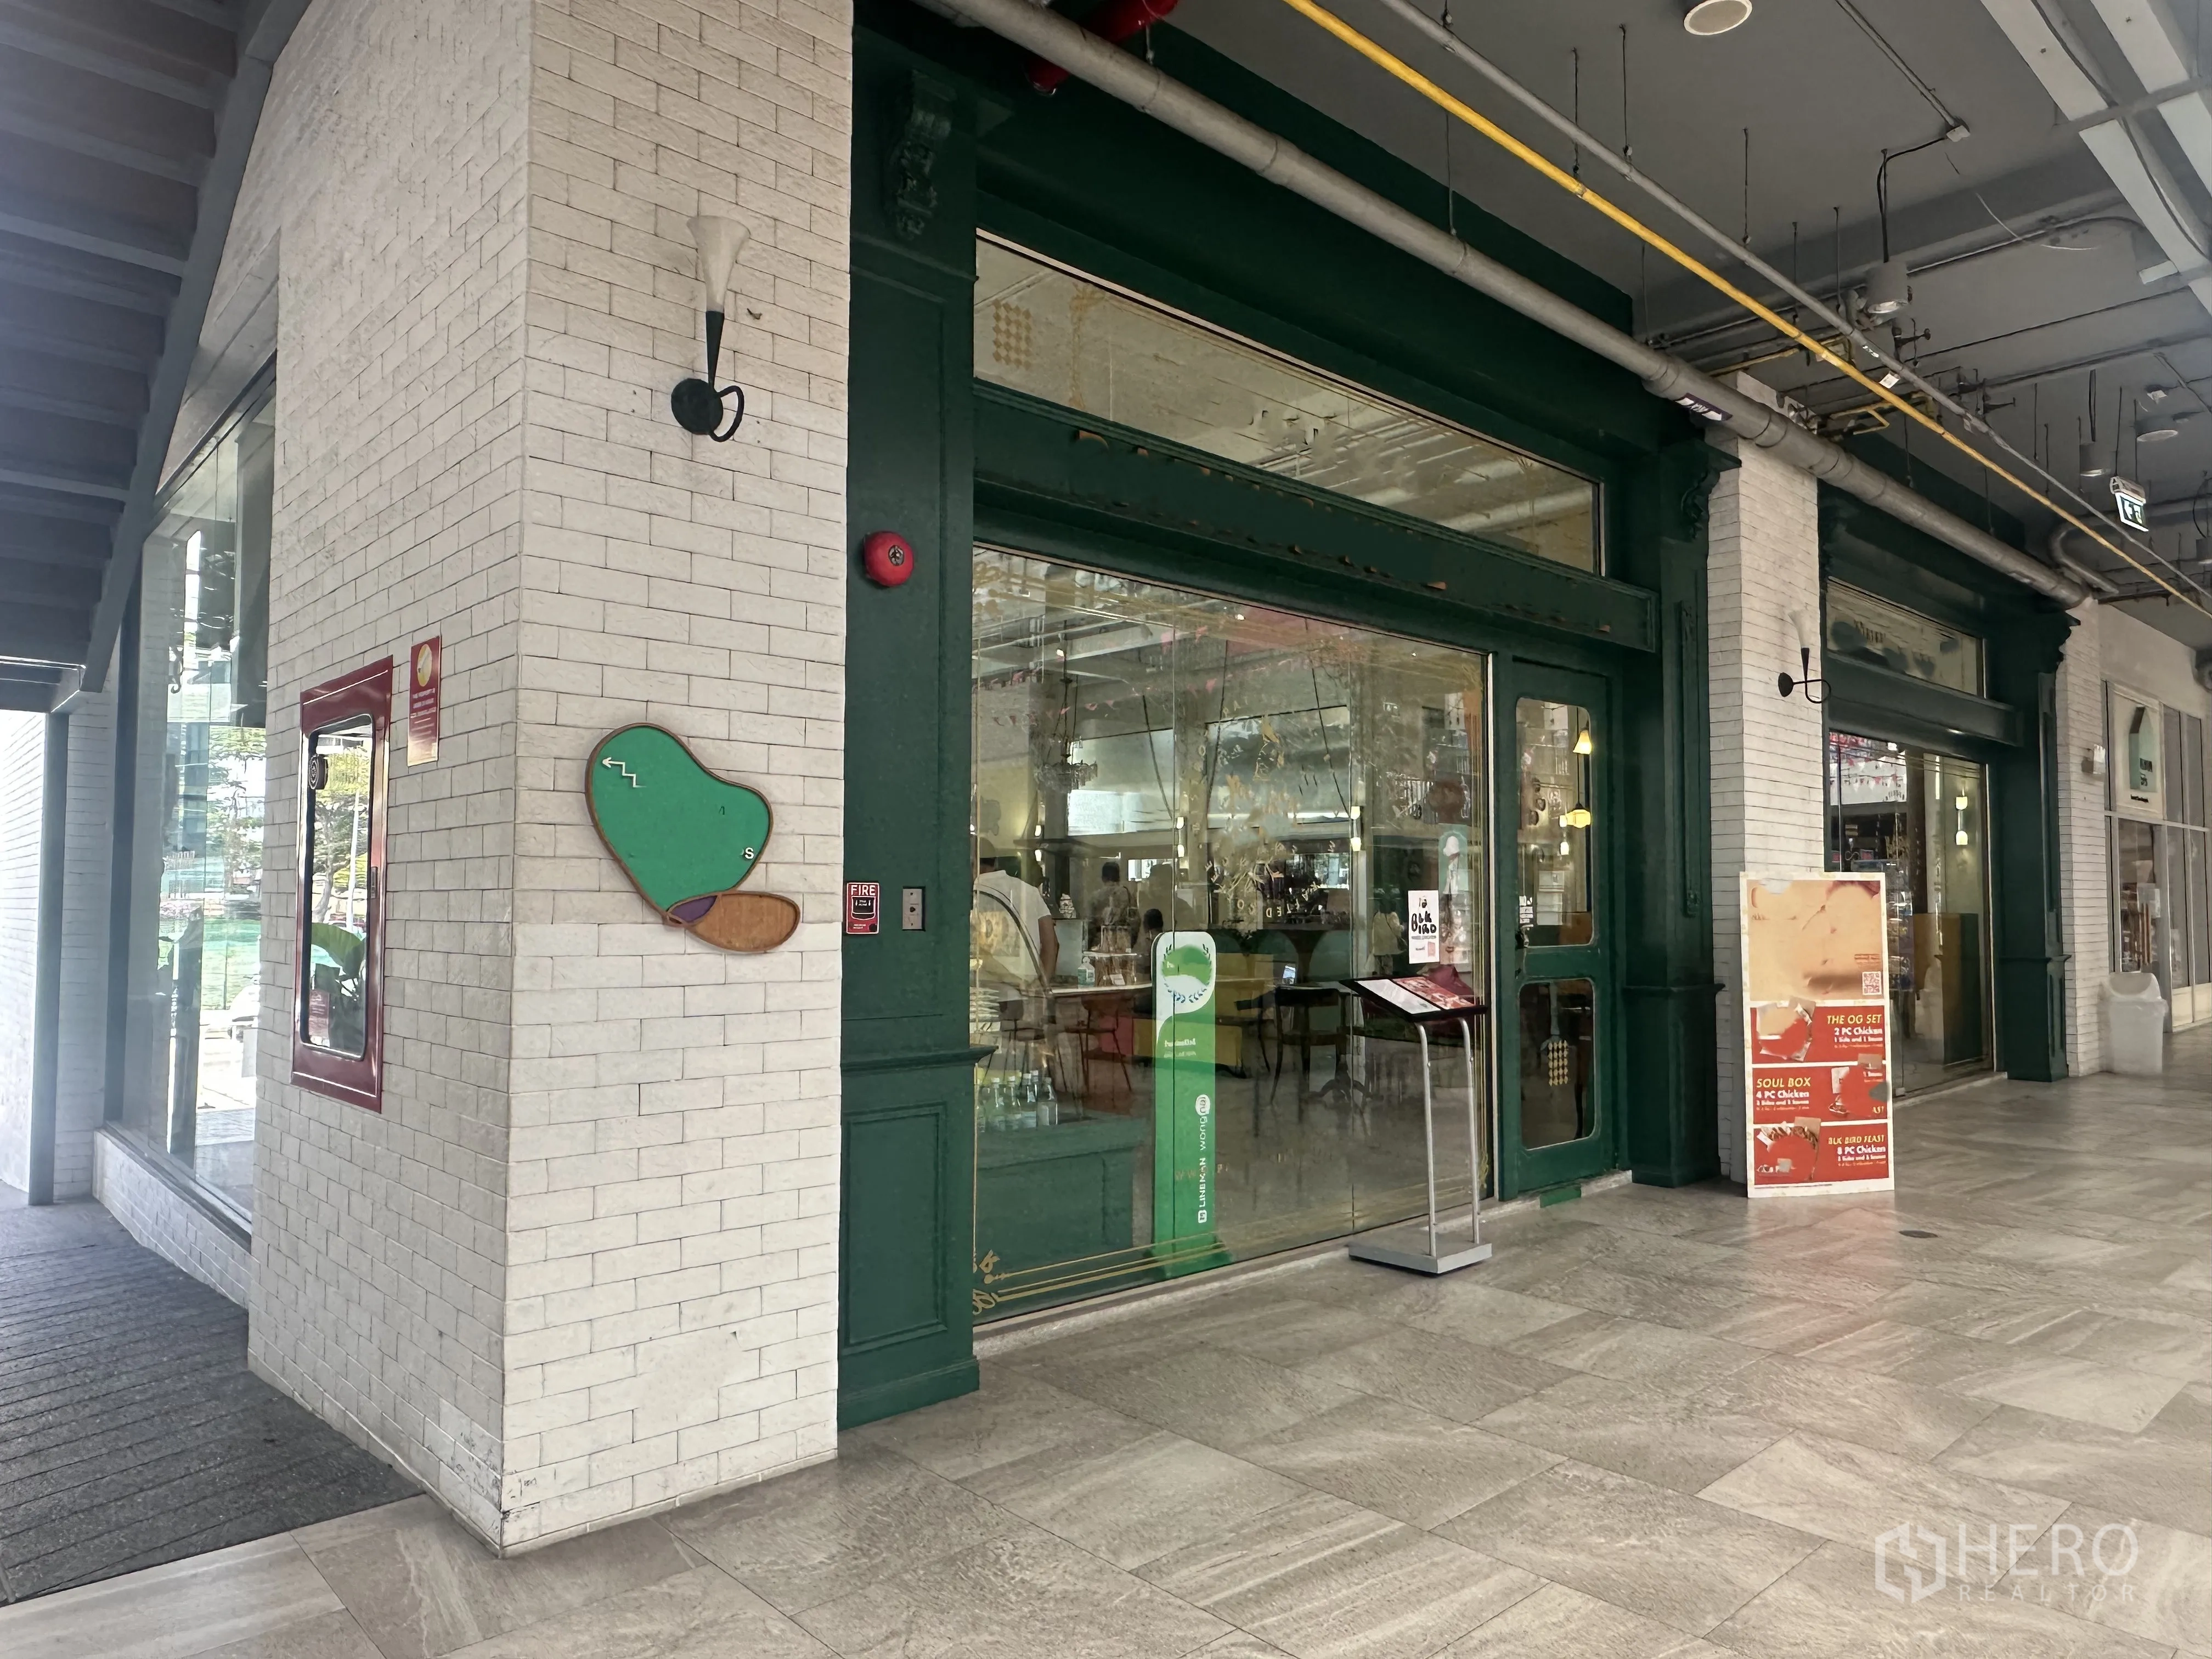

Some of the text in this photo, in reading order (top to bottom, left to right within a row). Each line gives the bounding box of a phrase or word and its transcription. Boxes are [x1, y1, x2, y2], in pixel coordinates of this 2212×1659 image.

[744, 847, 754, 859] S
[851, 884, 876, 896] FIRE
[1827, 1014, 1845, 1024] THE
[1866, 1014, 1882, 1024] SET
[1842, 1027, 1852, 1035] PC
[1853, 1026, 1883, 1035] Chicken
[1757, 1077, 1811, 1088] SOUL BOX
[1764, 1090, 1776, 1099] PC
[1777, 1089, 1809, 1098] Chicken
[1844, 1146, 1855, 1155] PC
[1857, 1144, 1886, 1154] Chicken
